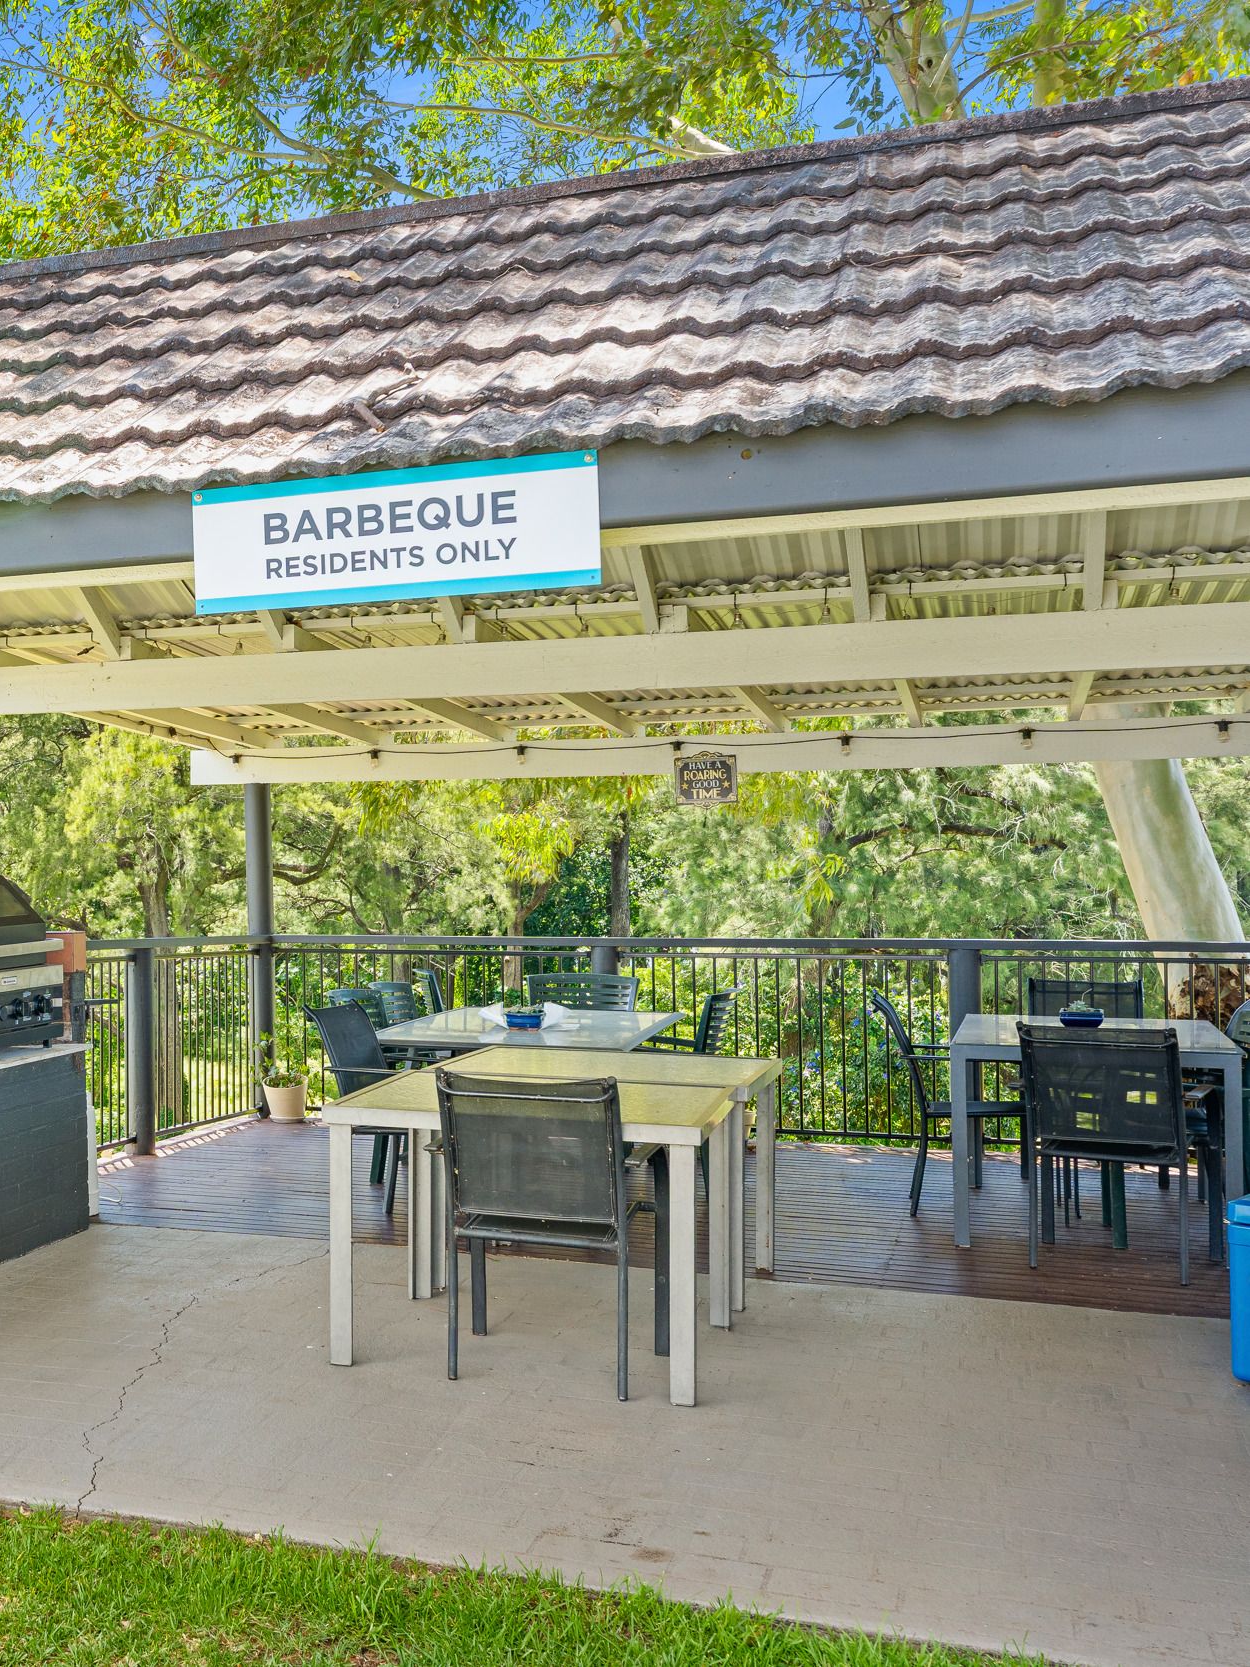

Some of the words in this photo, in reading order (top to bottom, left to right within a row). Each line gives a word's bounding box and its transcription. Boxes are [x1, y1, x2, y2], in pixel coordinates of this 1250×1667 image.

[262, 489, 518, 546] BARBEQUE
[266, 545, 424, 579] RESIDENTS
[436, 537, 518, 564] ONLY
[689, 761, 712, 770] HAVE
[684, 769, 726, 780] ROARING
[692, 780, 719, 788] GOOD
[691, 788, 721, 799] TIME
